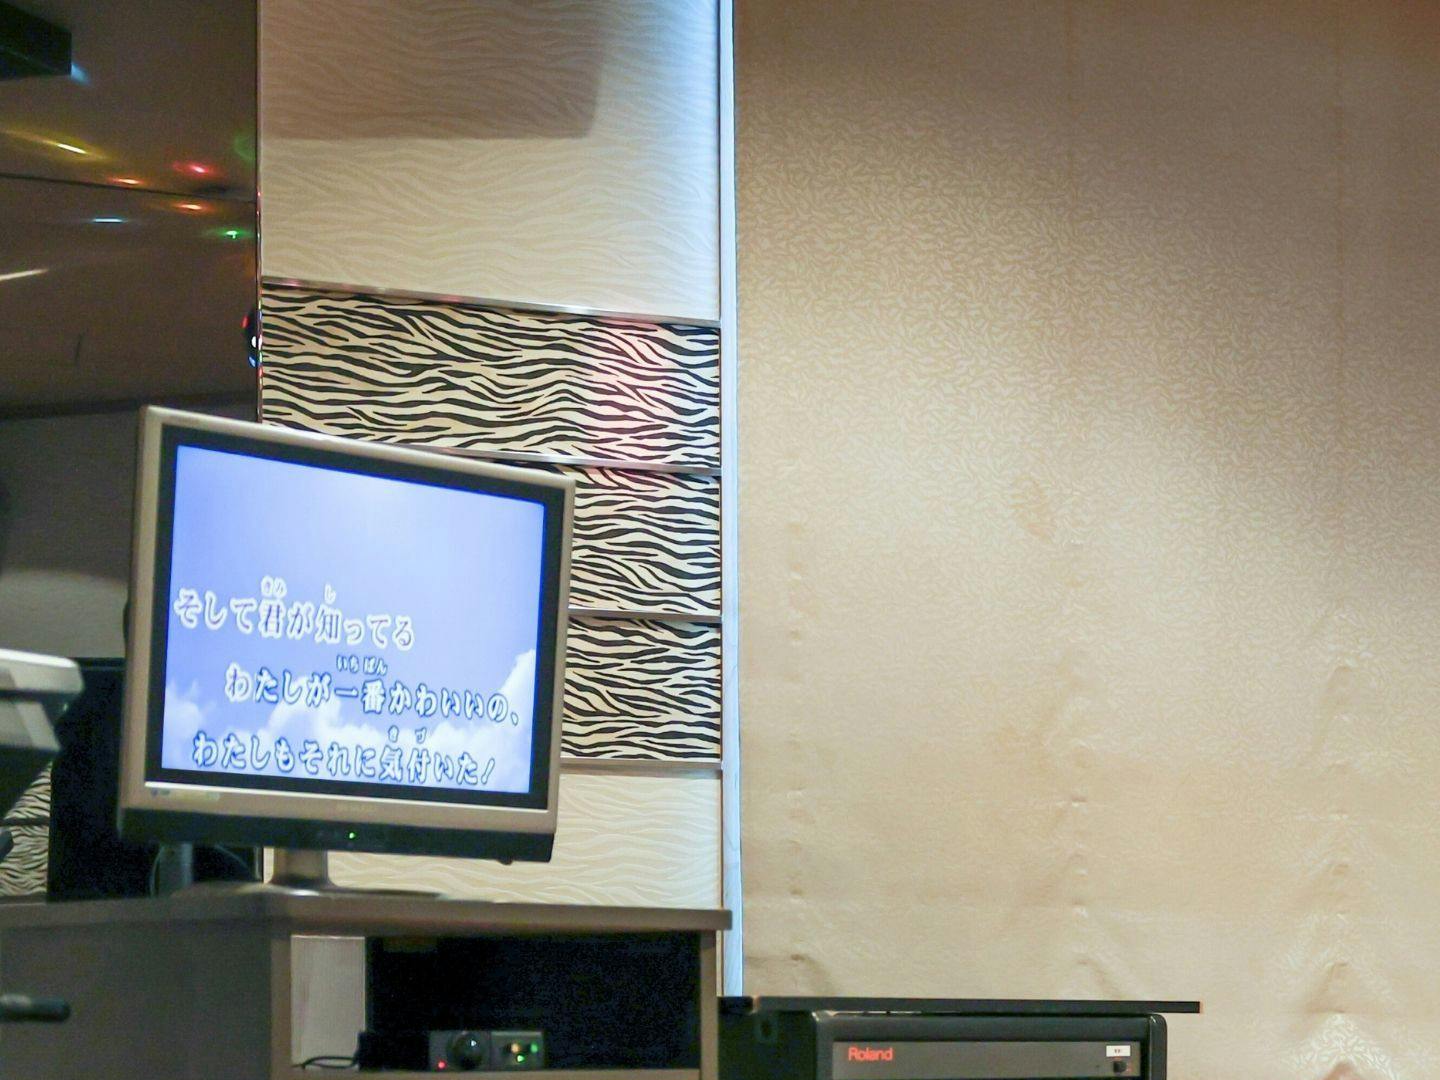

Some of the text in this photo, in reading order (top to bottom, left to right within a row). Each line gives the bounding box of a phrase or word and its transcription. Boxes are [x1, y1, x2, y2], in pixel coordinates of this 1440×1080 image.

[174, 588, 414, 650] そして君が知ってる
[224, 663, 520, 727] わたしが一番かわいいの、
[848, 1046, 893, 1061] Roland
